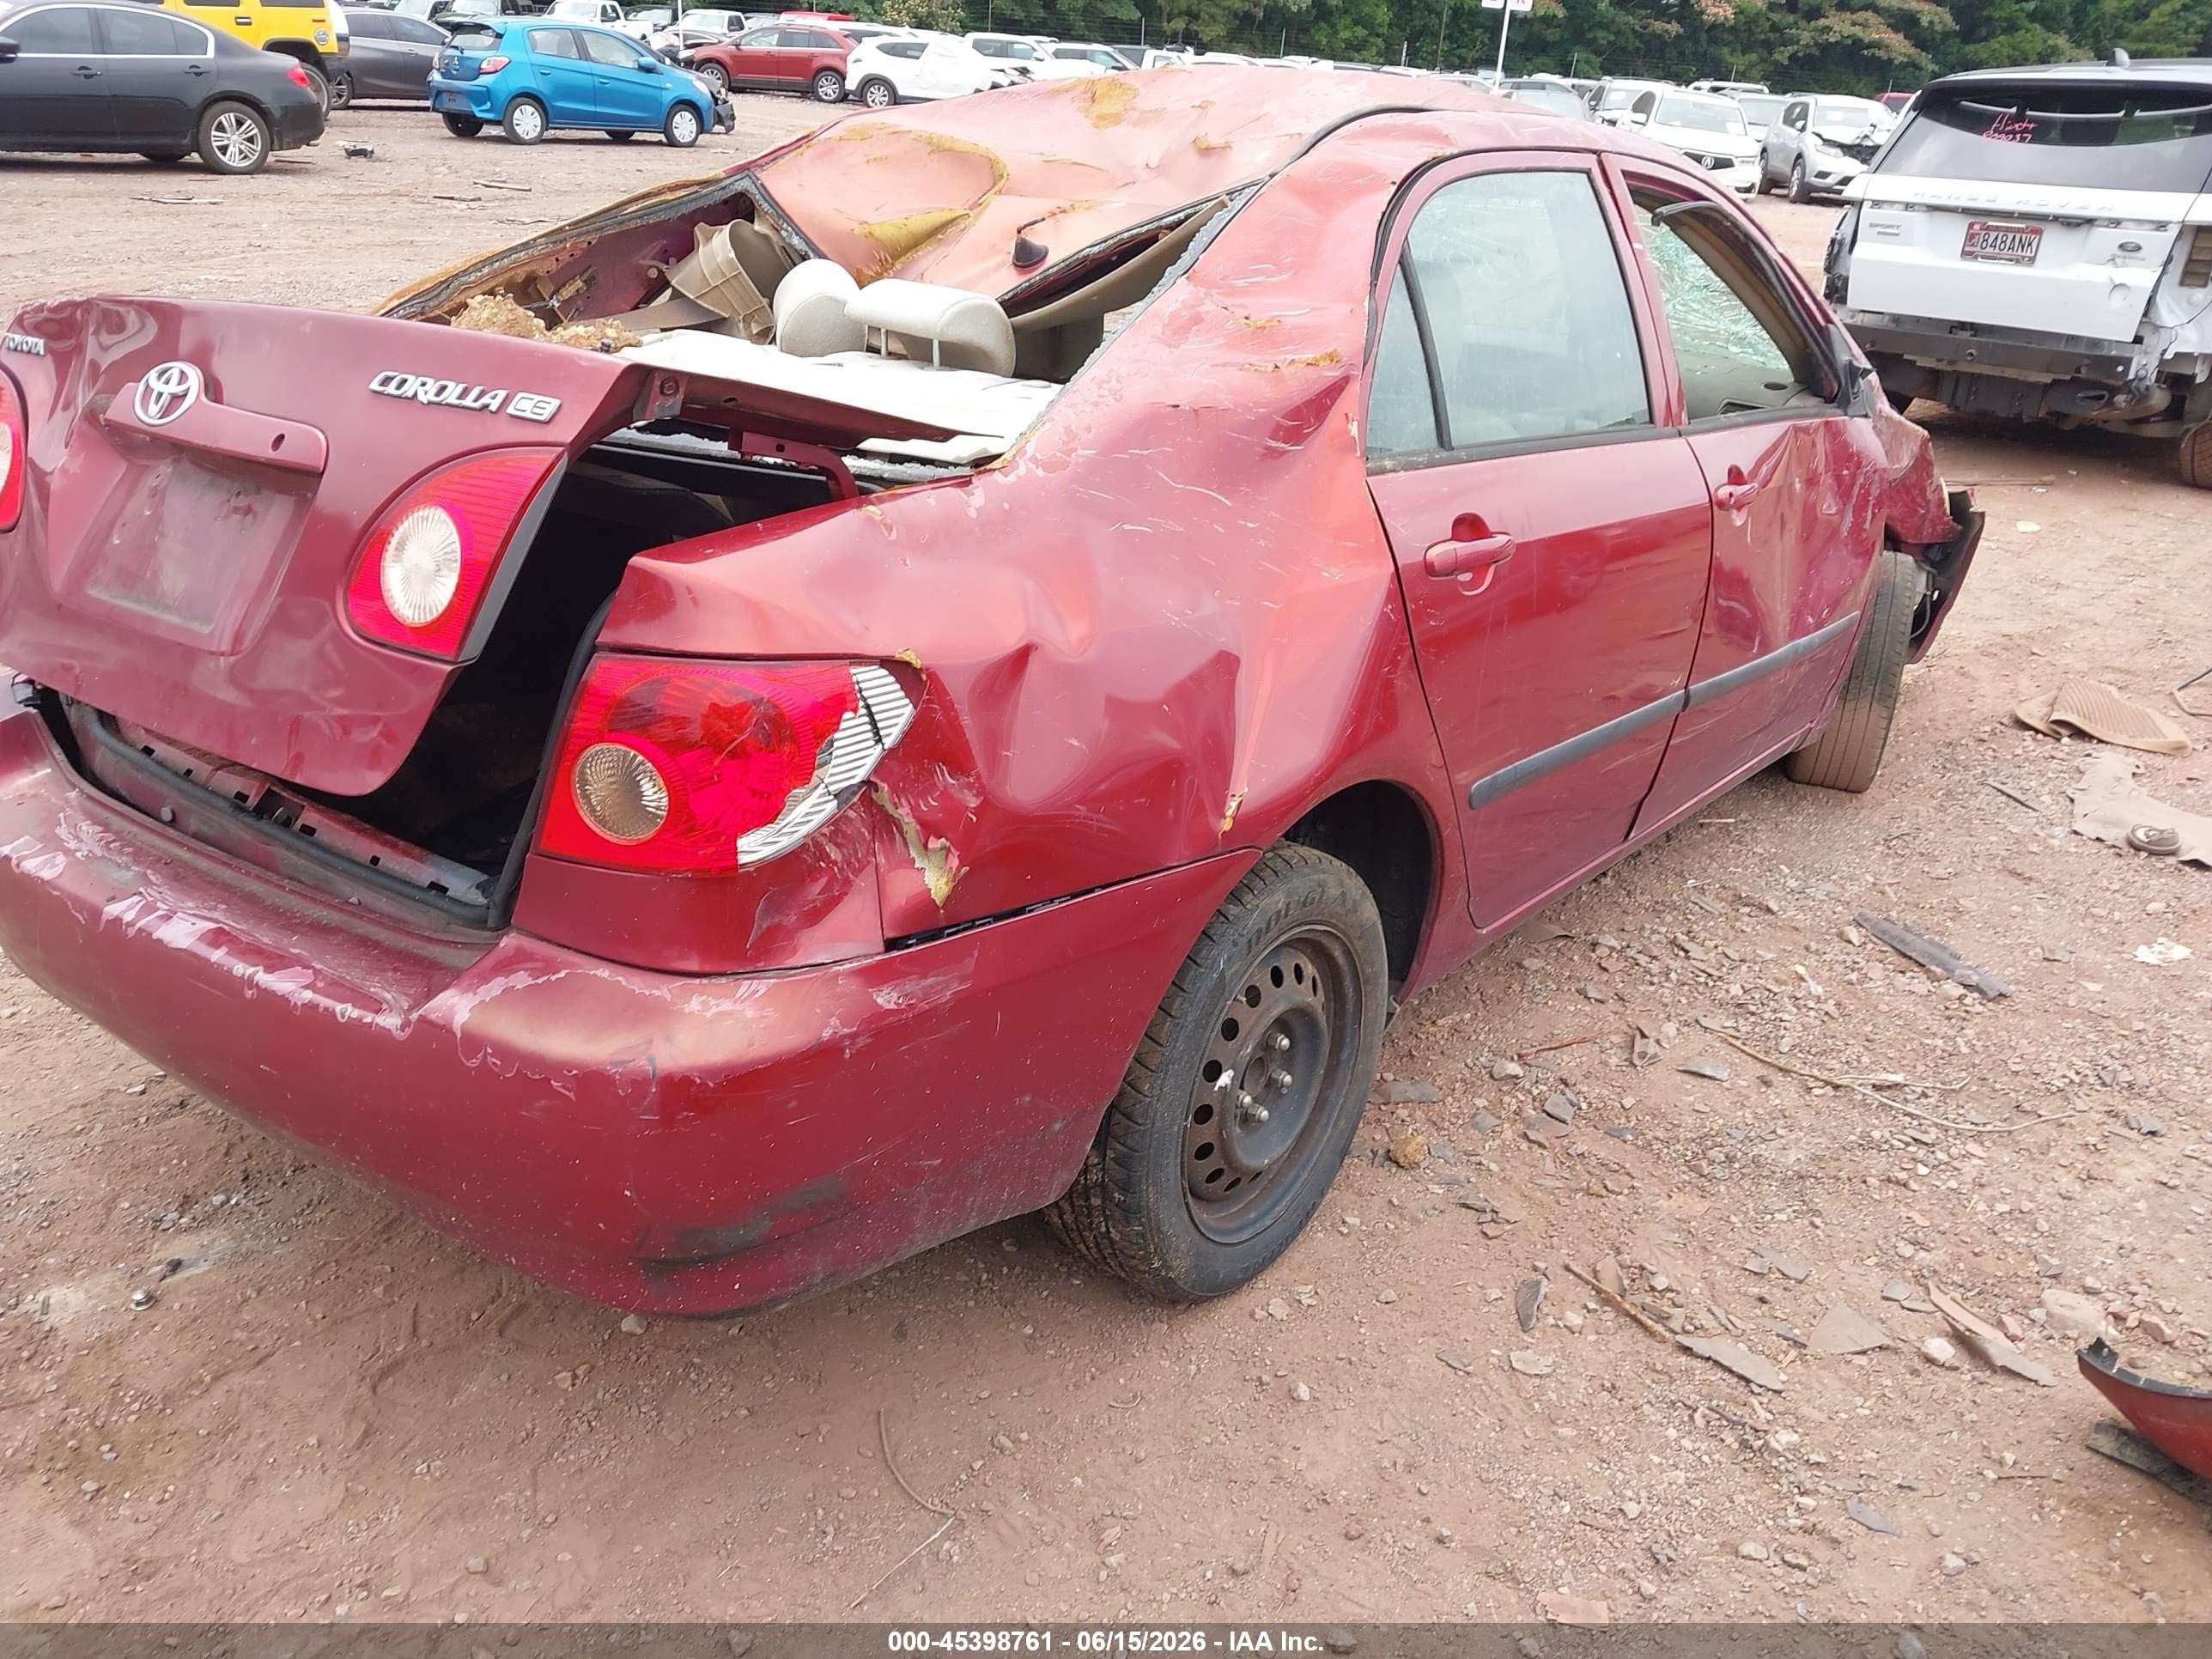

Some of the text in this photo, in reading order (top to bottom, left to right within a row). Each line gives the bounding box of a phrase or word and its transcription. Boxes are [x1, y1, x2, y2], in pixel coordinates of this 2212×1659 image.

[1979, 232, 2036, 255] 848ANK
[368, 370, 555, 418] COROLLA CE
